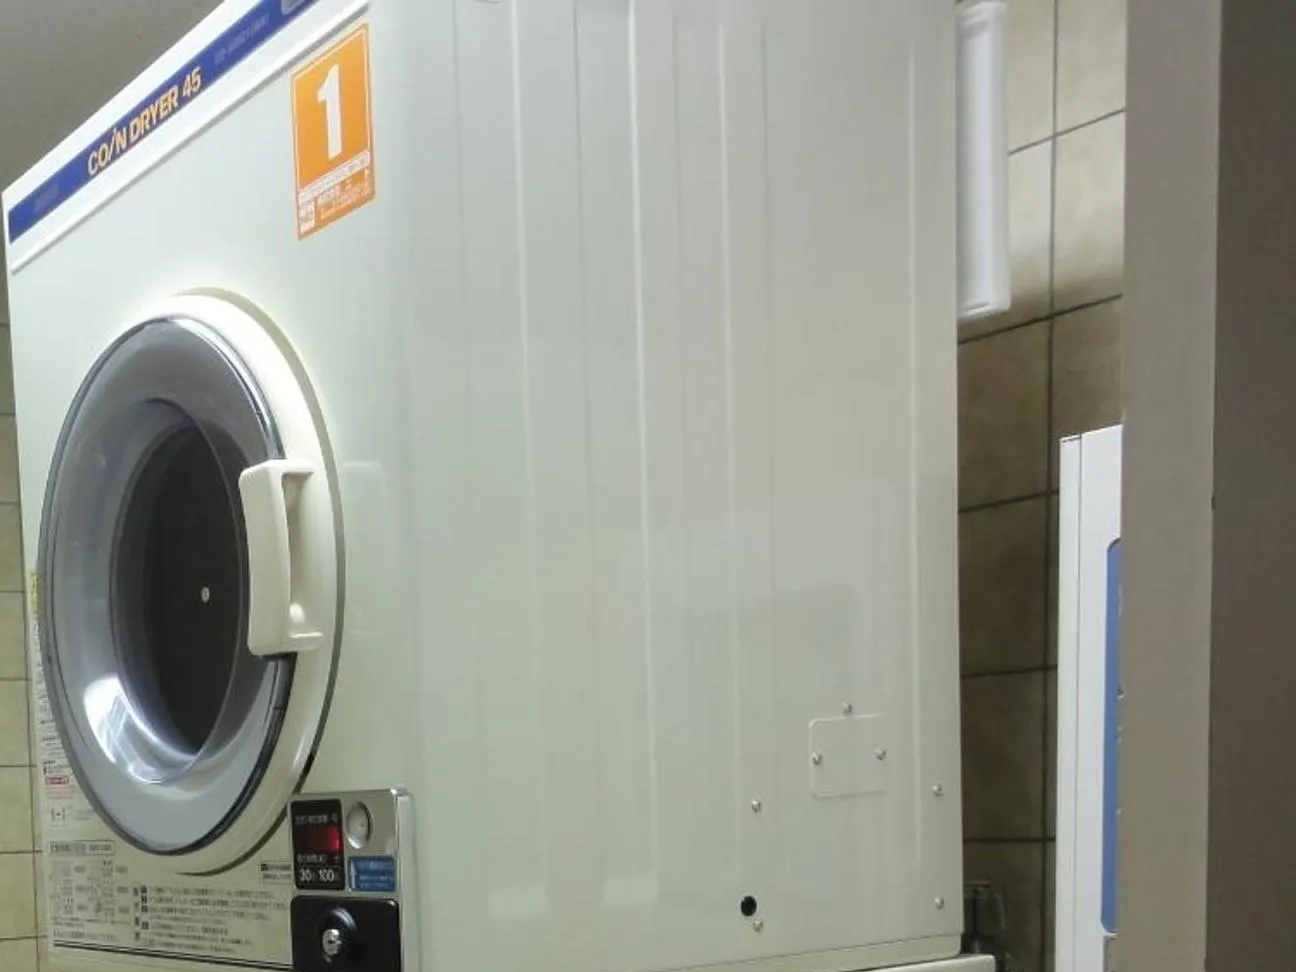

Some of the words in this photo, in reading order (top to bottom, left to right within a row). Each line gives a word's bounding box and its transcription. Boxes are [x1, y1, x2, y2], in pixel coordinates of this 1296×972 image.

[87, 127, 127, 176] COIN
[129, 84, 179, 142] DRYER
[182, 65, 202, 97] 45
[317, 63, 343, 161] 1
